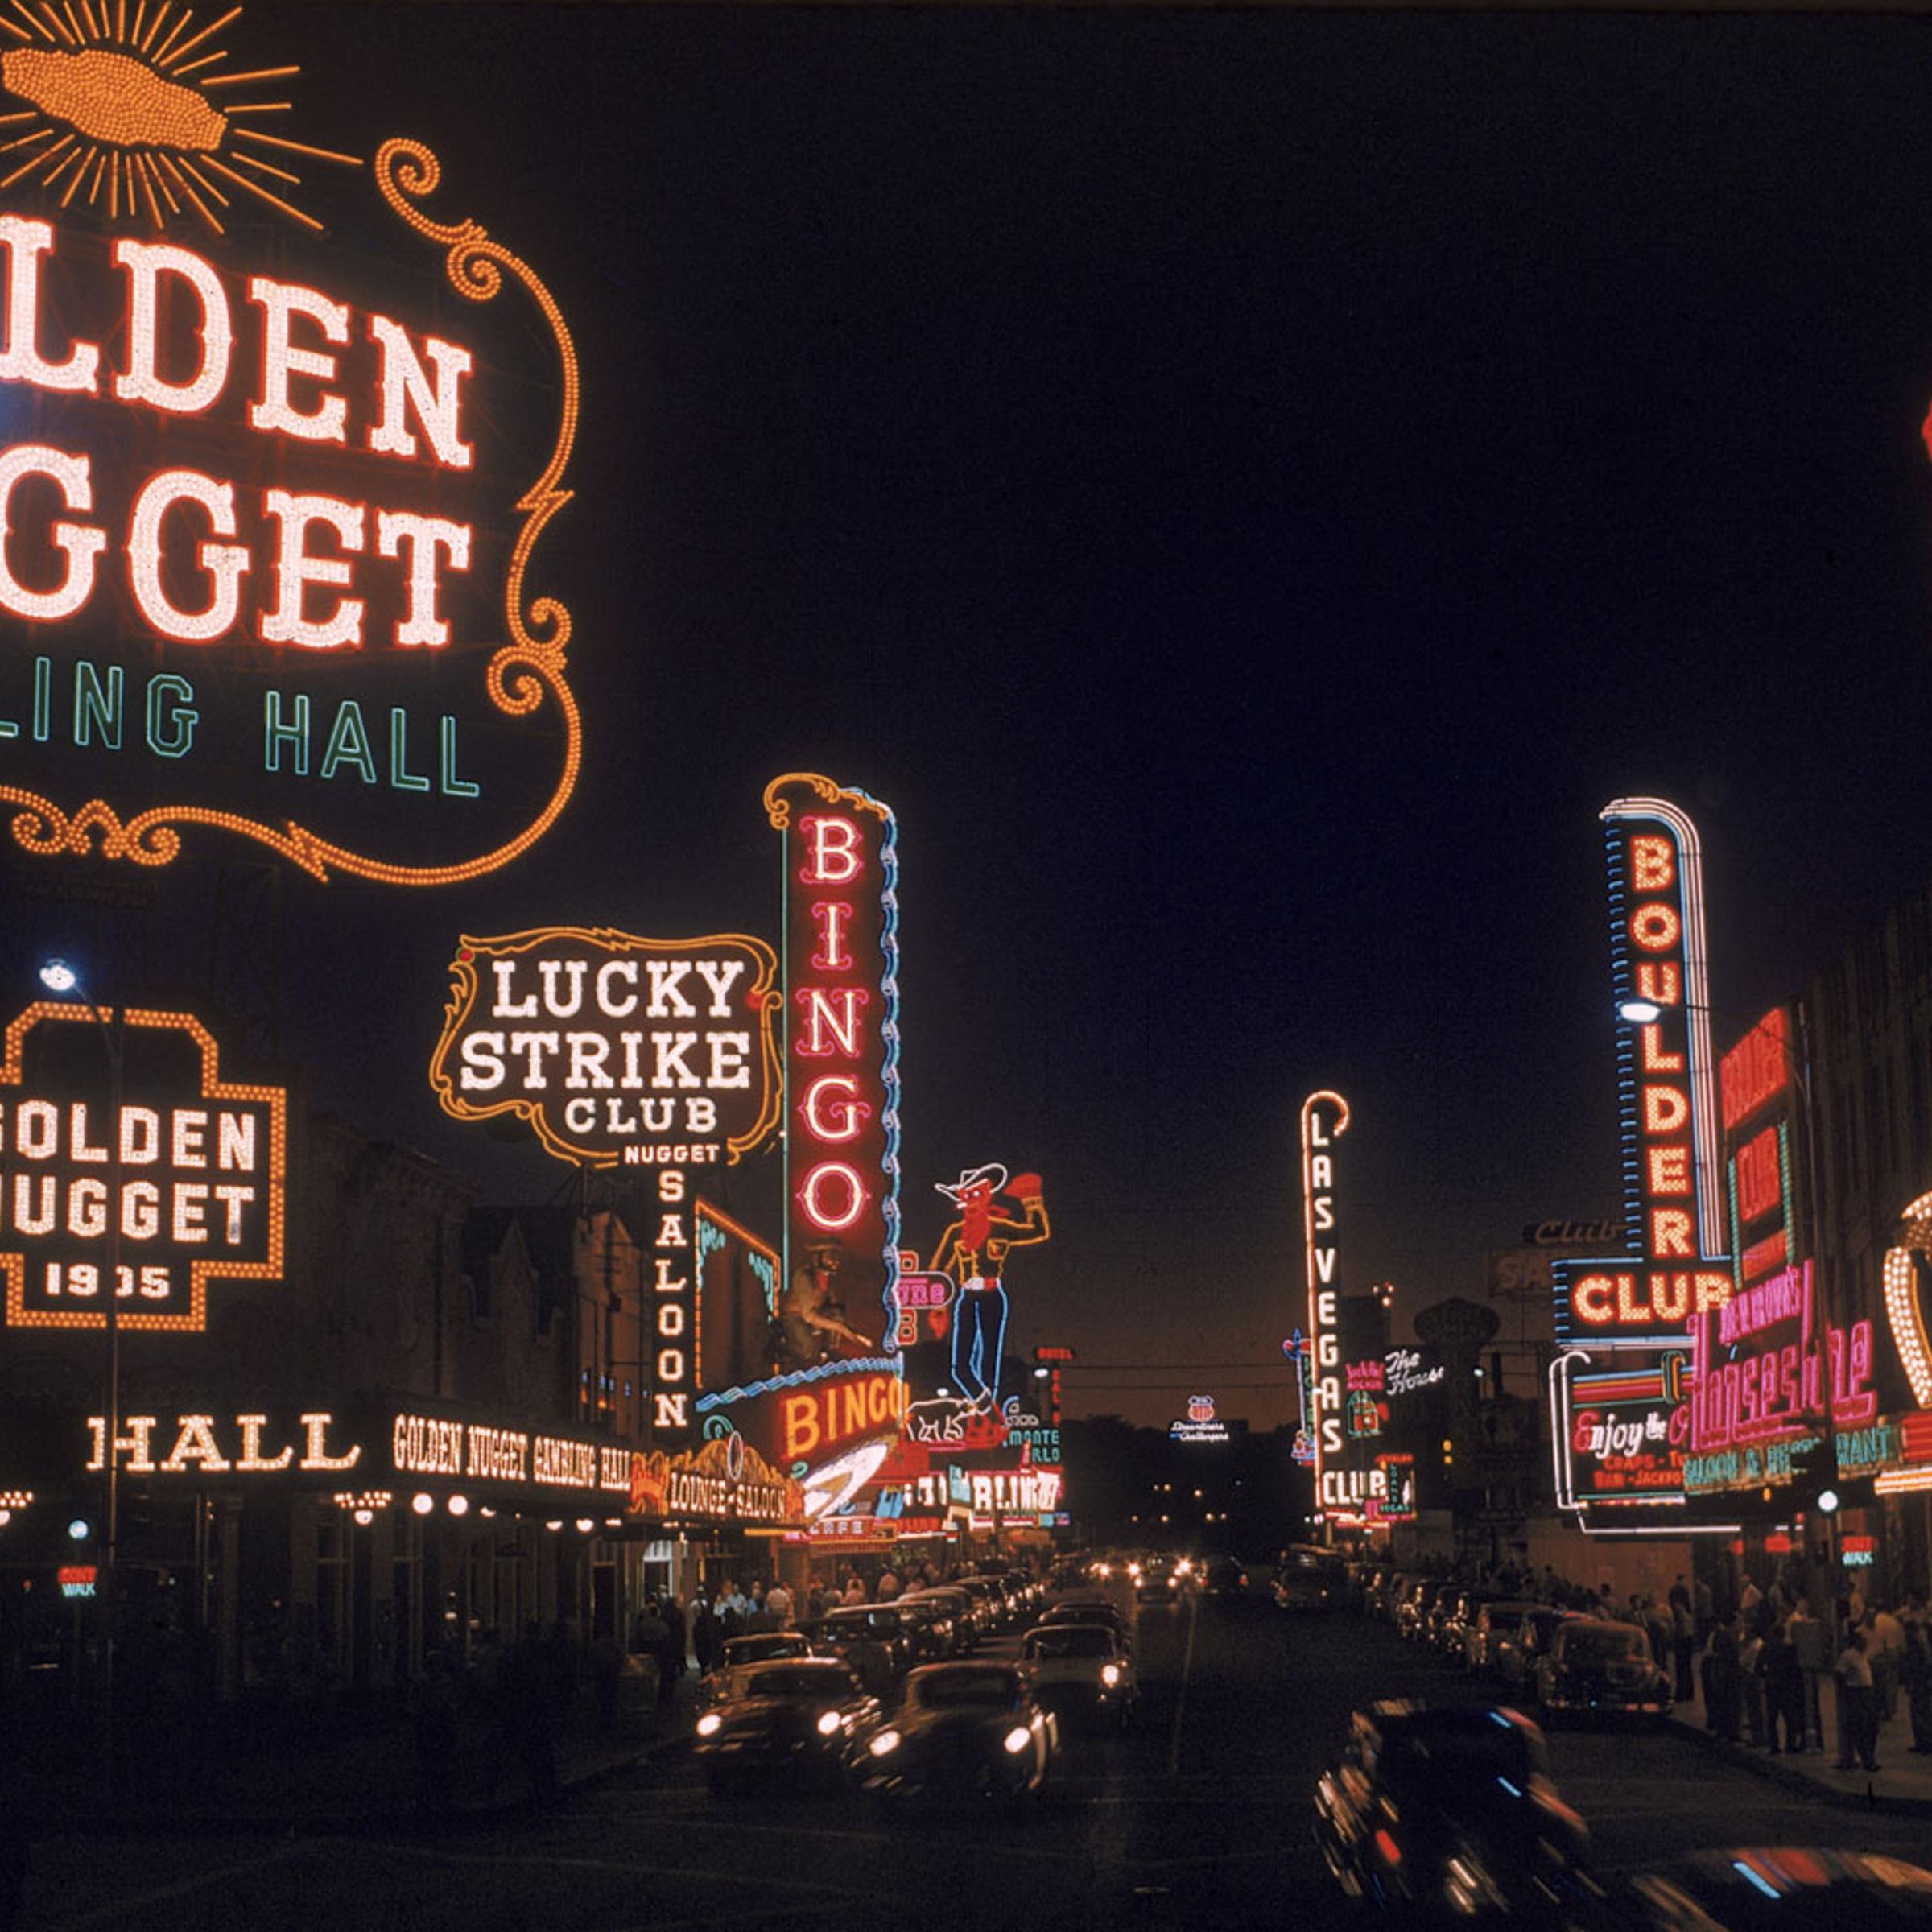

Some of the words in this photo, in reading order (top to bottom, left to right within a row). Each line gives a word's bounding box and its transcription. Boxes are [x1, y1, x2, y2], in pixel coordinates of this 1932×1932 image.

[0, 444, 473, 648] GGET
[265, 691, 480, 797] HALL
[492, 961, 745, 1018] LUCKY
[795, 815, 870, 1232] BINGO
[460, 1032, 750, 1090] STRIKE
[1630, 836, 1693, 1258] BOULDER
[0, 1099, 255, 1172] OLDEN
[565, 1097, 717, 1133] CLUB
[624, 1144, 720, 1164] NUGGET
[1311, 1113, 1333, 1230] LAS
[0, 1173, 255, 1245] UGGET
[654, 1170, 688, 1427] SALOON
[1315, 1247, 1342, 1453] VEGAS
[85, 1413, 361, 1472] HALL
[392, 1414, 463, 1476] GOLDEN
[467, 1426, 528, 1481] NUGGET
[533, 1435, 597, 1488] GAMBLING
[600, 1447, 632, 1492] HALL
[785, 1376, 910, 1458] BINGO
[1573, 1411, 1644, 1459] Enjoy
[62, 1583, 96, 1596] WALK
